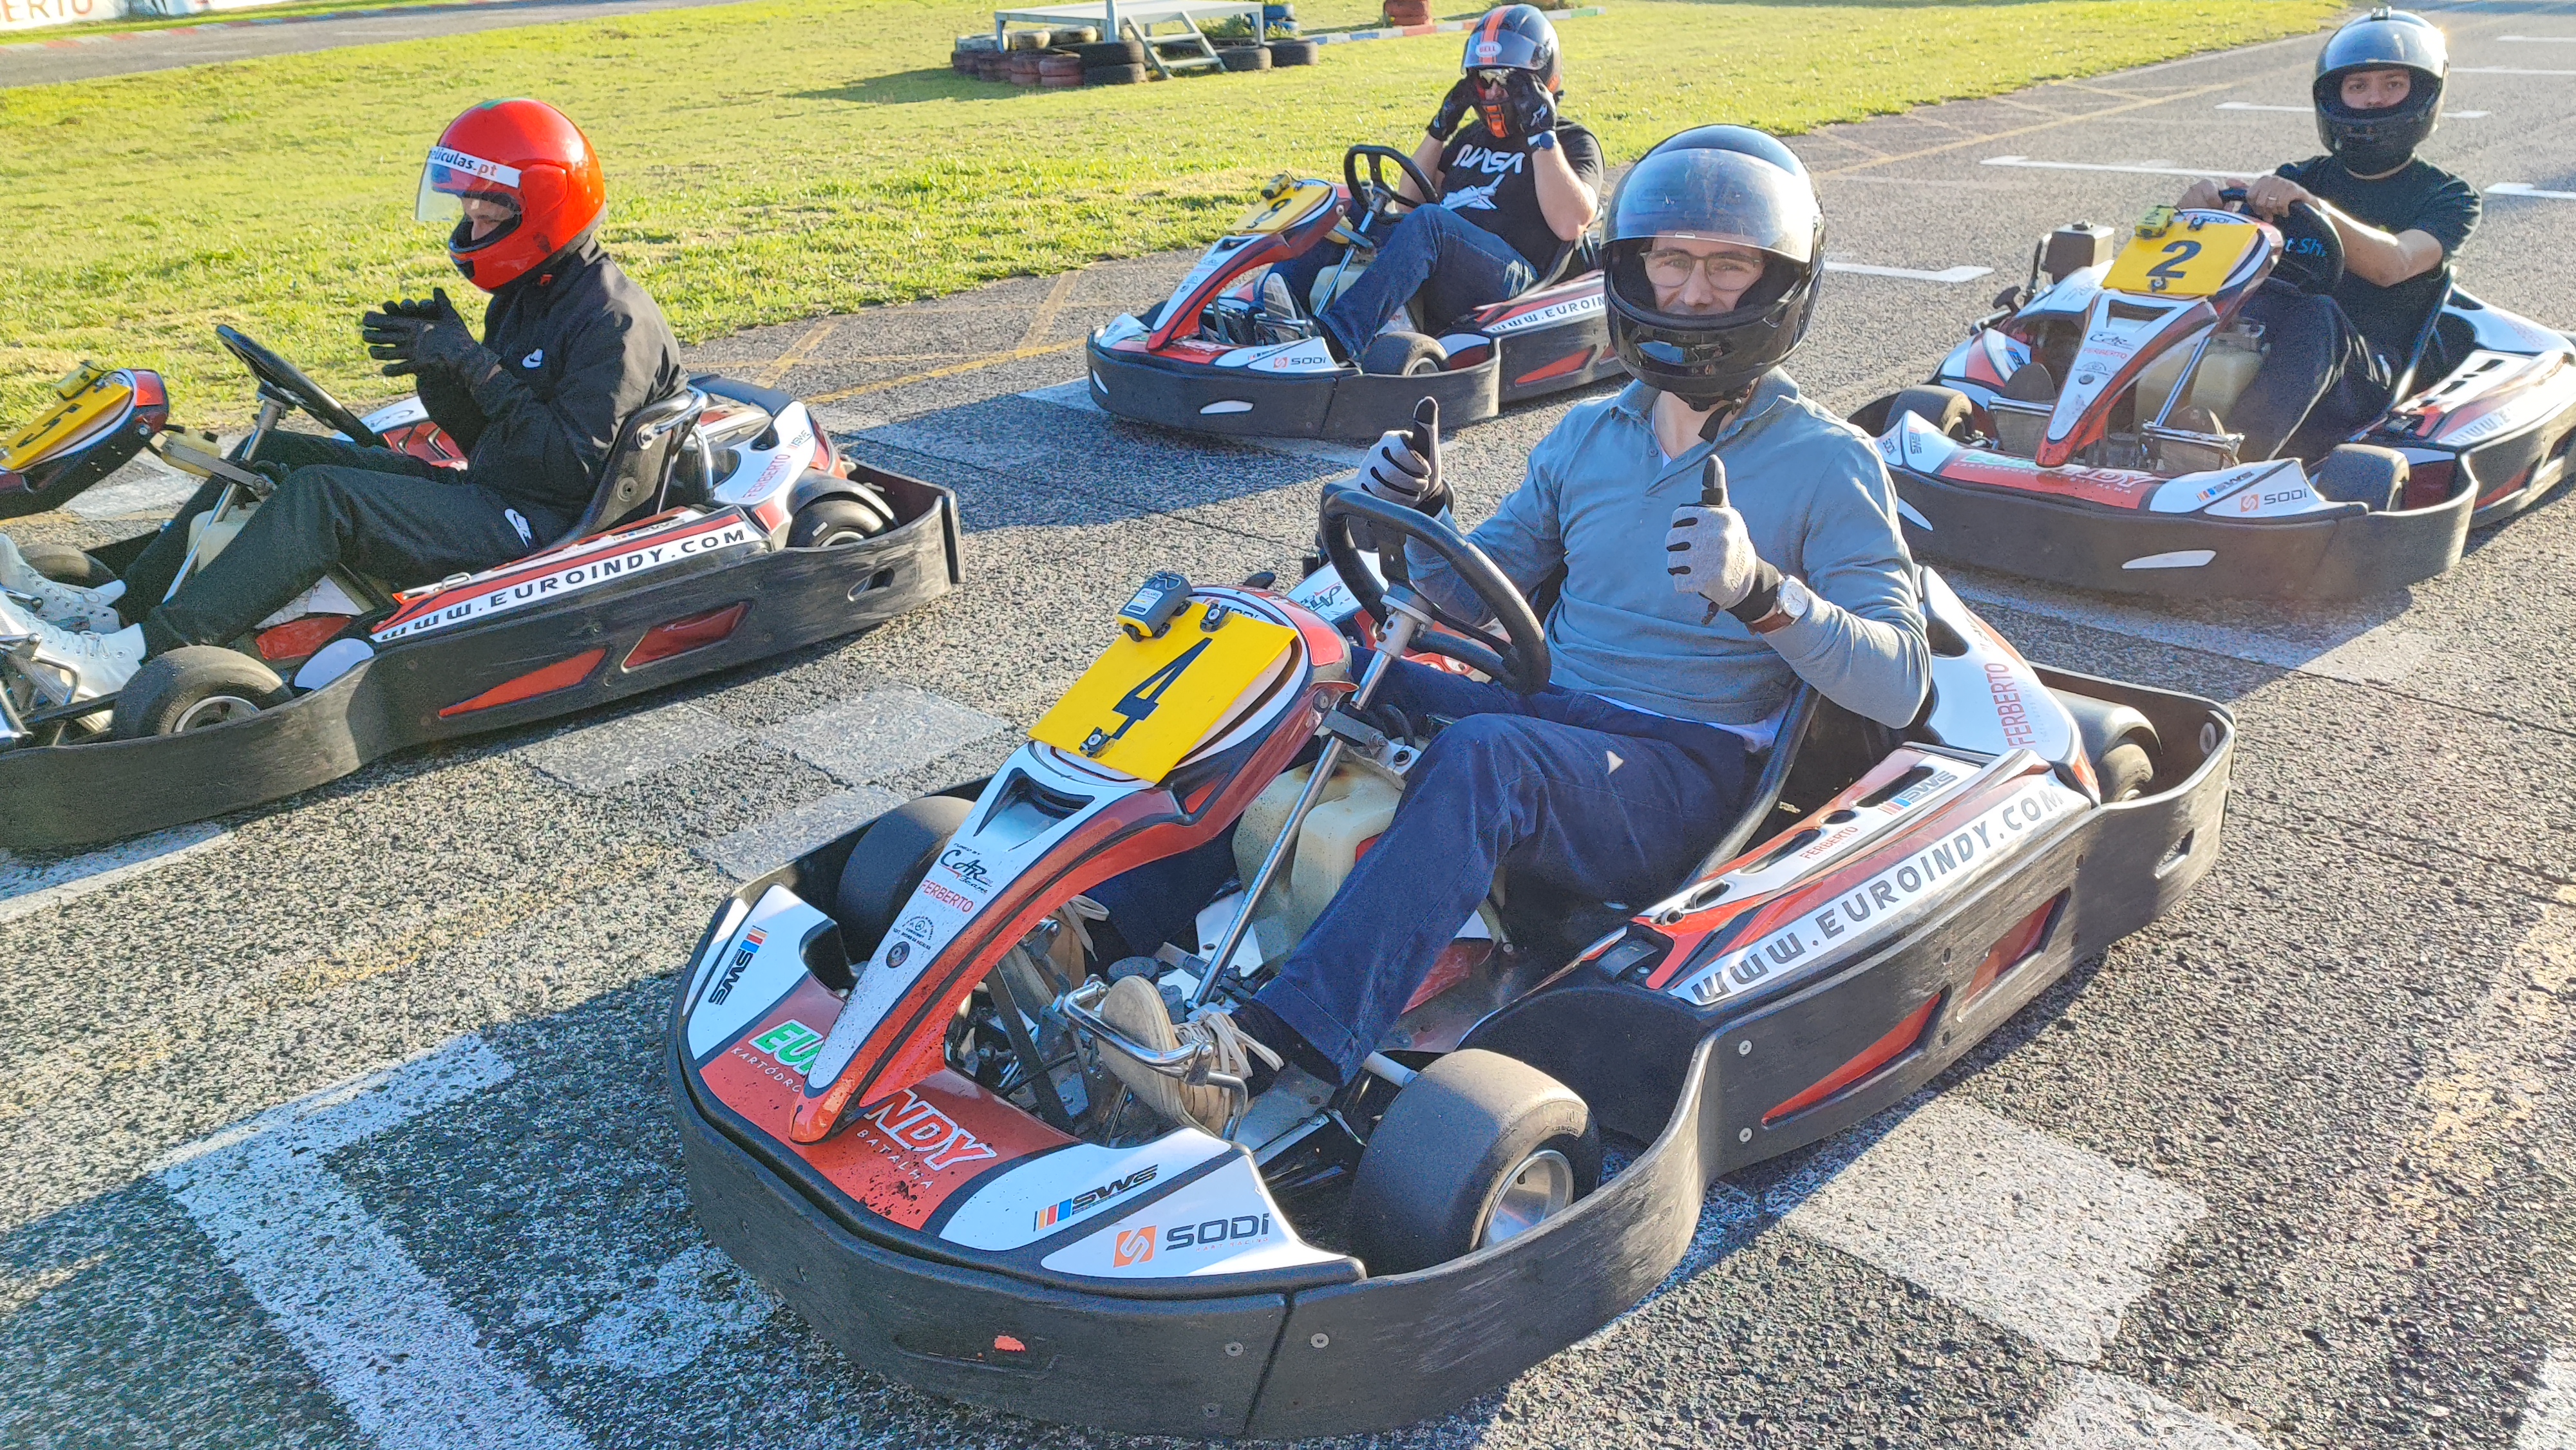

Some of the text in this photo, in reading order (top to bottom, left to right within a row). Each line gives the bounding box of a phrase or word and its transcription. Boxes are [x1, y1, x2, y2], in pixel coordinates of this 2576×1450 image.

[1452, 144, 1526, 174] NASA
[2146, 240, 2202, 279] 2
[1492, 296, 1605, 332] WWW.EUROIN
[381, 529, 745, 641] WWW.EUROINDY.COM
[1113, 637, 1213, 740] 4
[1984, 663, 2036, 747] FERBERTO
[1899, 771, 1958, 802] SWS
[1799, 827, 1859, 859] FERBERTO
[919, 880, 974, 913] FERBERTO
[1689, 788, 2065, 1002] WWW.EUROINDY.COM
[708, 948, 753, 1005] SWS
[857, 1129, 934, 1190] BATALHA
[1072, 1163, 1159, 1210] SWS
[1166, 1212, 1270, 1251] SODI
[1229, 1237, 1269, 1247] RACING
